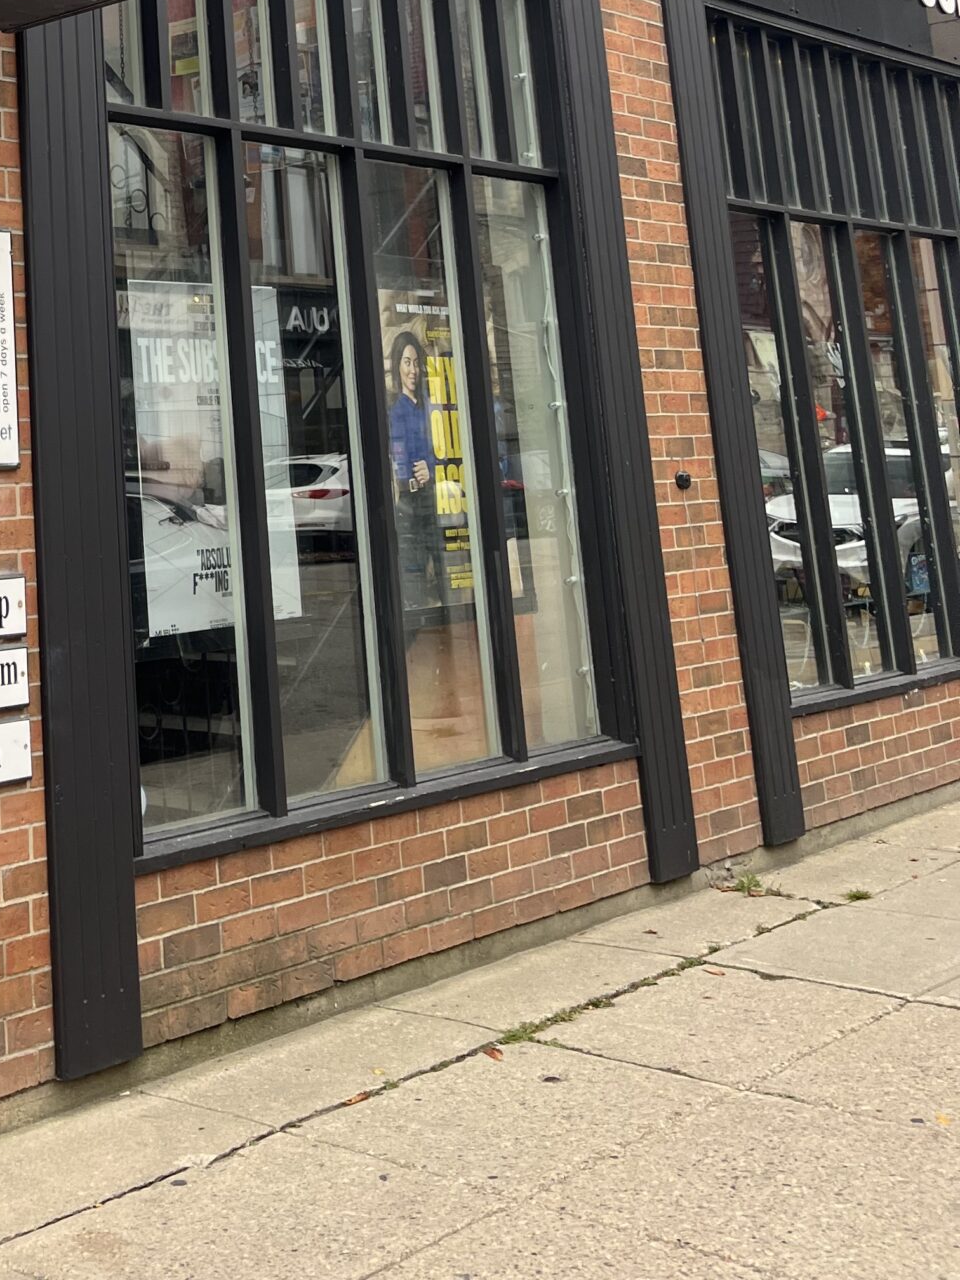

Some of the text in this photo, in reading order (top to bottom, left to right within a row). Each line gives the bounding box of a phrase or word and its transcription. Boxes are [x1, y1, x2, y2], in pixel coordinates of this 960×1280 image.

[0, 337, 8, 367] days
[137, 338, 176, 383] THE
[3, 384, 11, 413] open
[426, 356, 458, 404] MY
